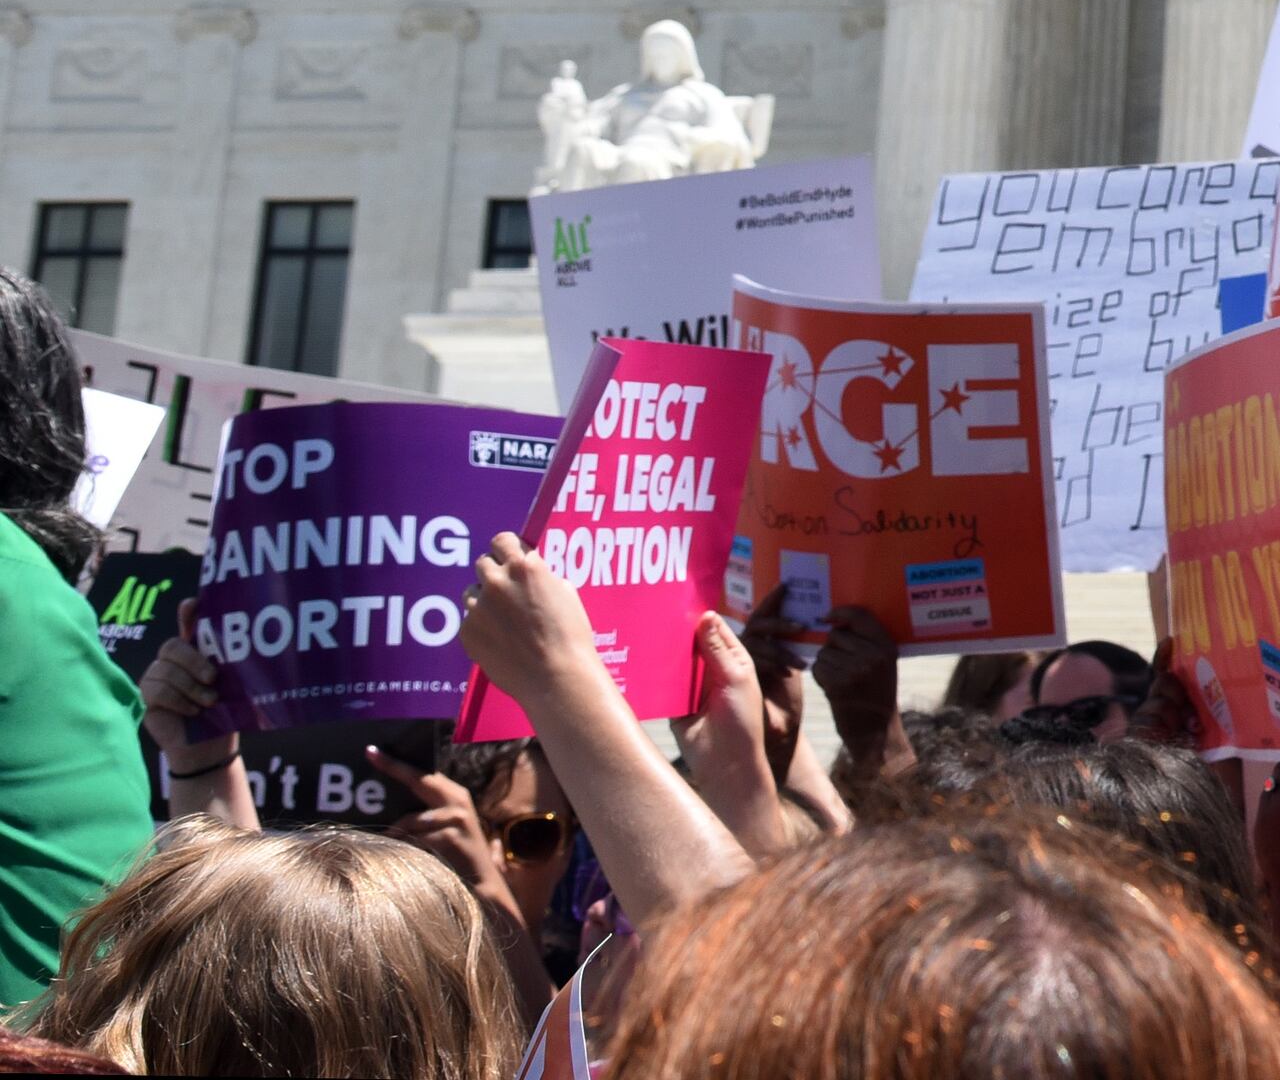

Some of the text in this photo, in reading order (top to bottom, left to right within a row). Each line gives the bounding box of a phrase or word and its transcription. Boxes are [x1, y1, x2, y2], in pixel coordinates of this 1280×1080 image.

[584, 378, 707, 441] OTECT
[734, 320, 1029, 479] RGE
[552, 453, 716, 521] FE, LEGAL
[538, 525, 693, 589] BORTION
[911, 588, 938, 600] NOT
[975, 585, 984, 594] A
[197, 595, 468, 665] ABORTIO
[316, 763, 386, 816] Be
